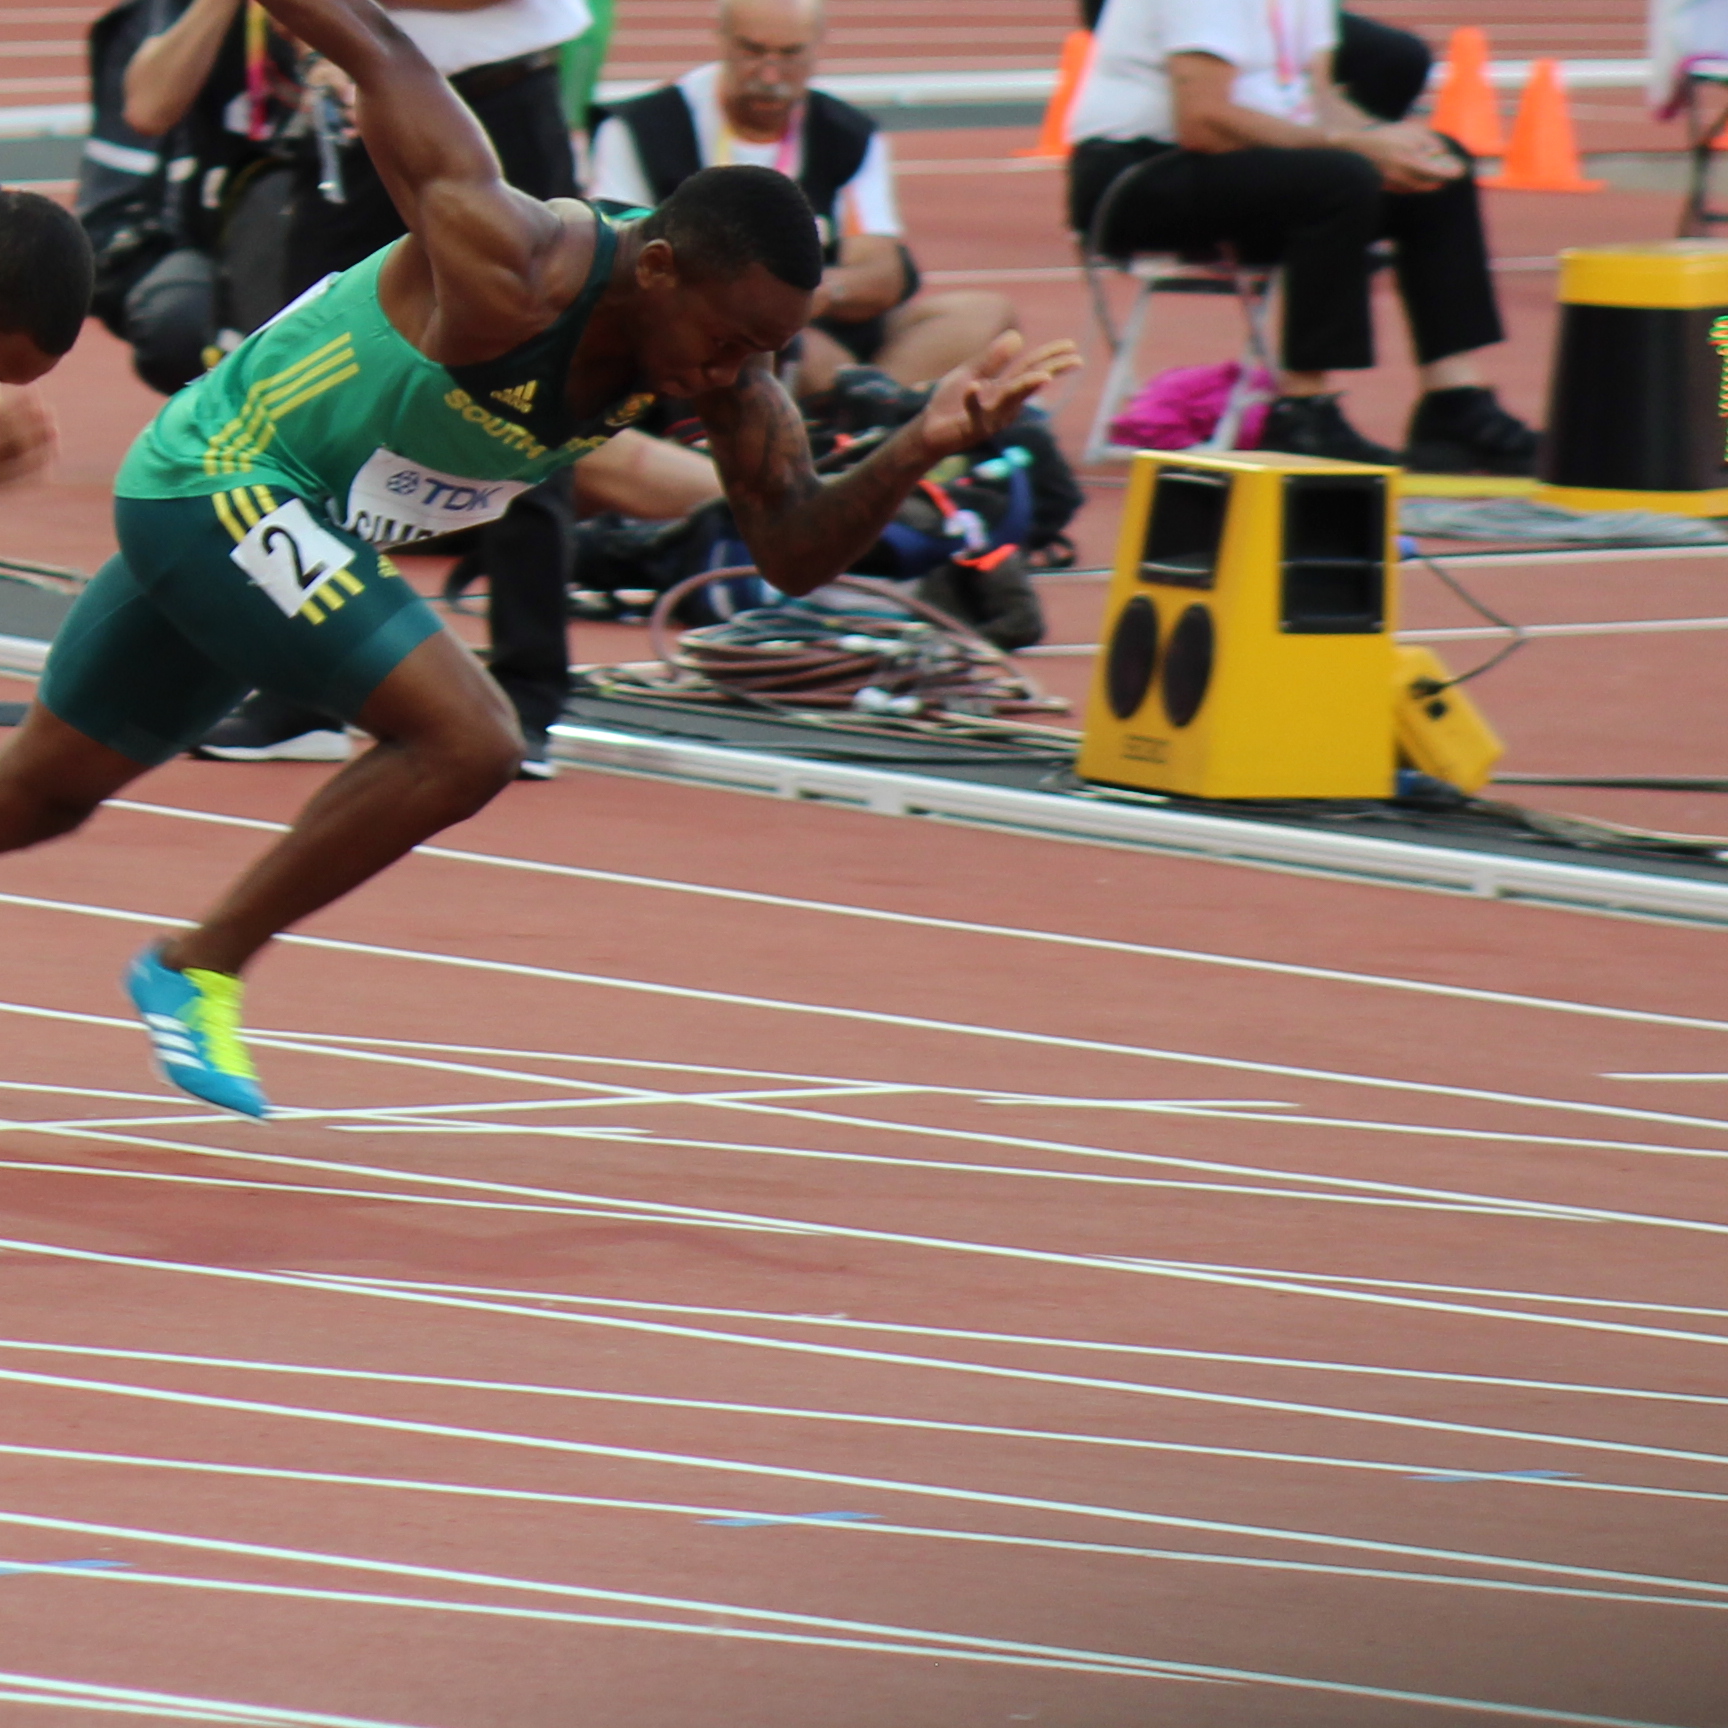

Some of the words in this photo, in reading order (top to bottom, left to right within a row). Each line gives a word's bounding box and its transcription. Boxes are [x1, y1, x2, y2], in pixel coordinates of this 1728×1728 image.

[444, 388, 547, 460] SOUTH
[422, 478, 503, 512] TDK
[262, 526, 329, 591] 2
